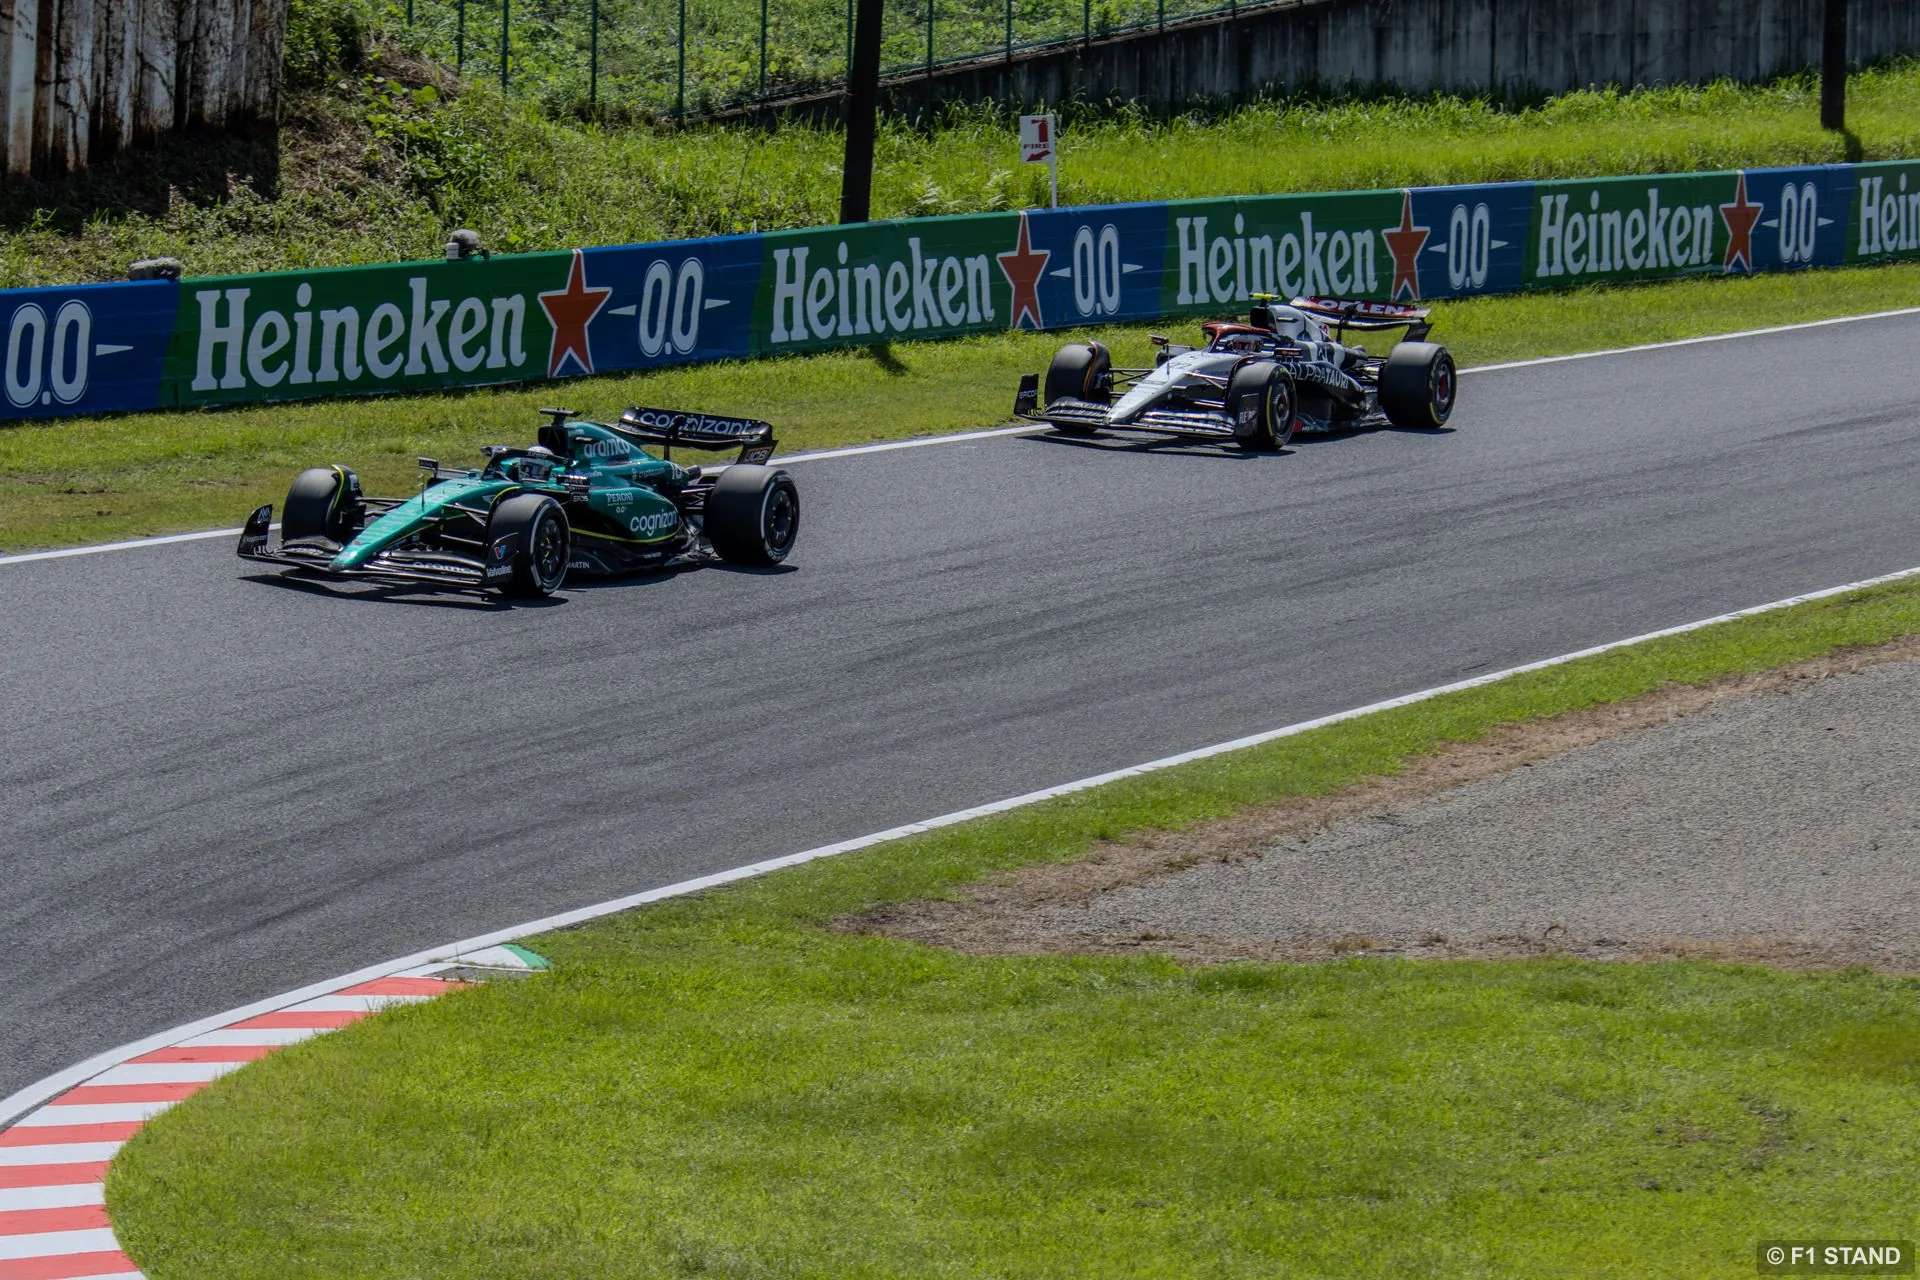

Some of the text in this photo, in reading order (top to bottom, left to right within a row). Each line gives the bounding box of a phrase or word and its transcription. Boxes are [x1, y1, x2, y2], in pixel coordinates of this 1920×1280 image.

[1176, 205, 1490, 305] Heineken 0.0
[1536, 183, 1818, 278] Heineken 0.0
[191, 258, 704, 392] Heineken 0.0
[770, 225, 1120, 343] Heineken 0.0
[4, 301, 92, 406] 0.0
[584, 438, 631, 458] aramco
[746, 450, 768, 462] JCB
[605, 492, 634, 502] PERONI
